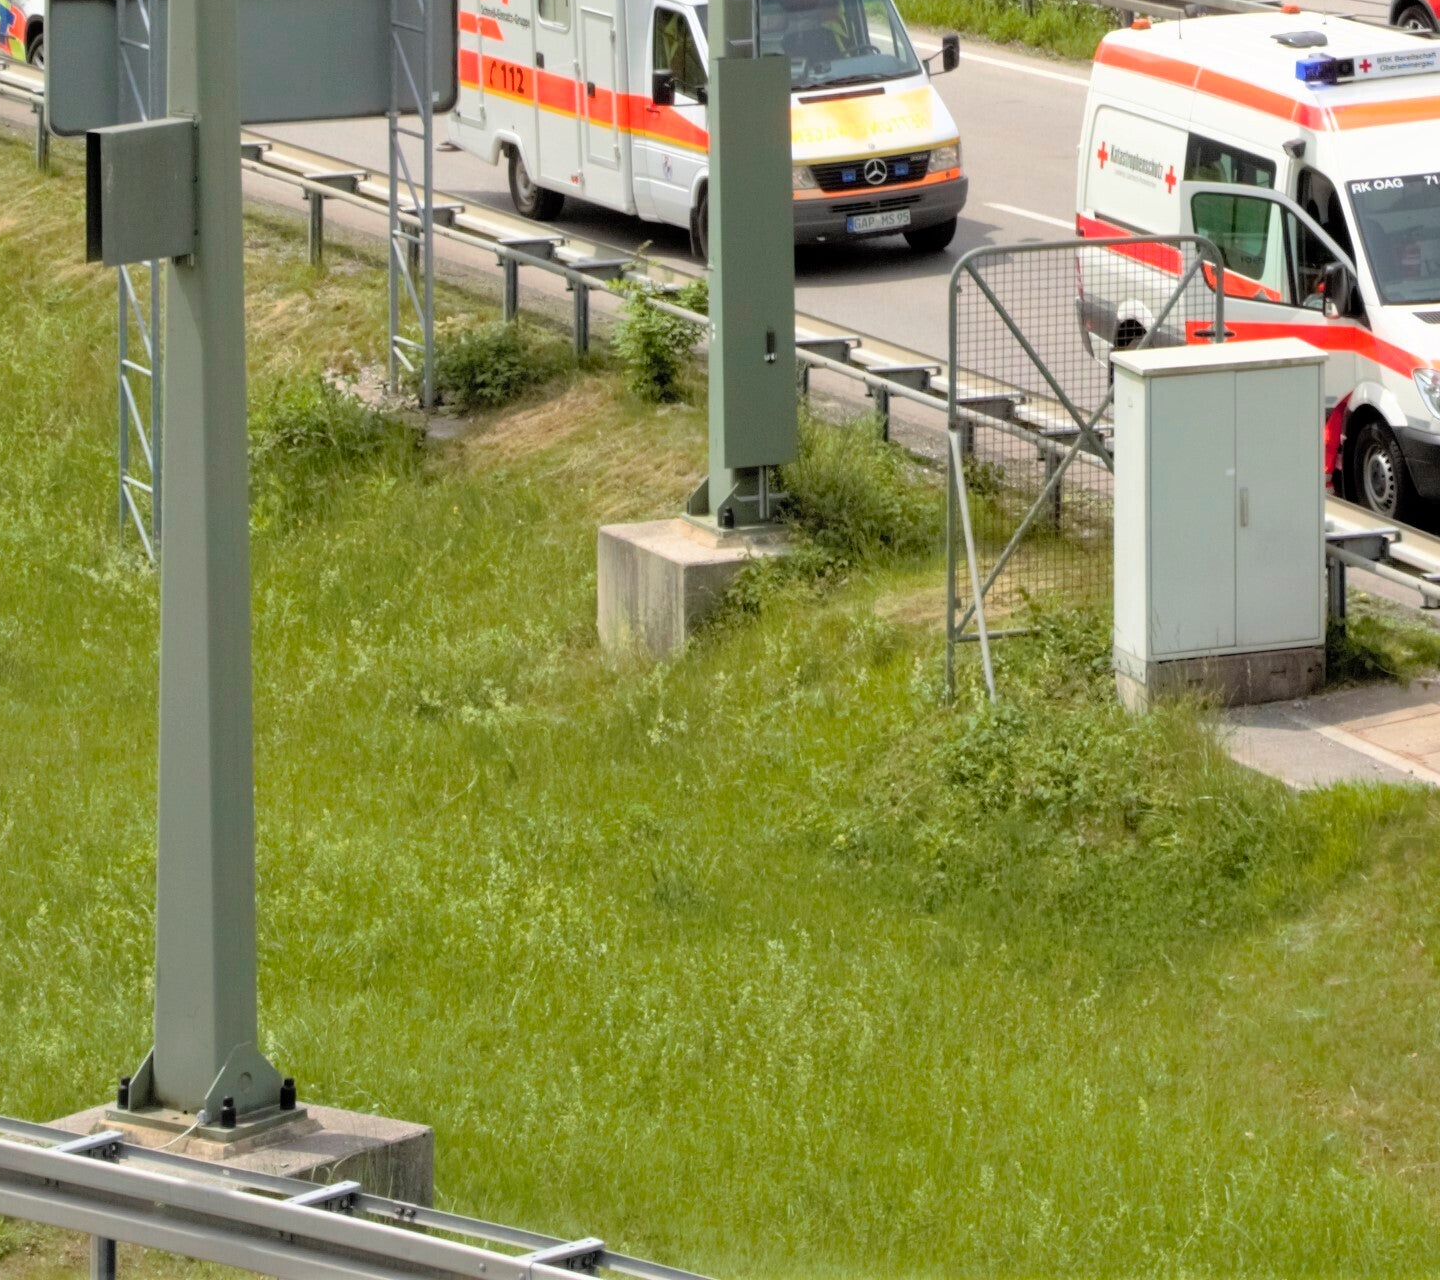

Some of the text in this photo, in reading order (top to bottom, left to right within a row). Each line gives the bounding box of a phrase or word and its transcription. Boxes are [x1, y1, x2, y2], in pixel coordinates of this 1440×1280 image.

[1377, 51, 1437, 64] BRK Bereitschaft
[1379, 60, 1435, 72] Oberammergau
[501, 64, 525, 94] 112
[1351, 181, 1372, 195] RK
[1373, 177, 1404, 191] OAG
[853, 208, 910, 230] GAP MS 95
